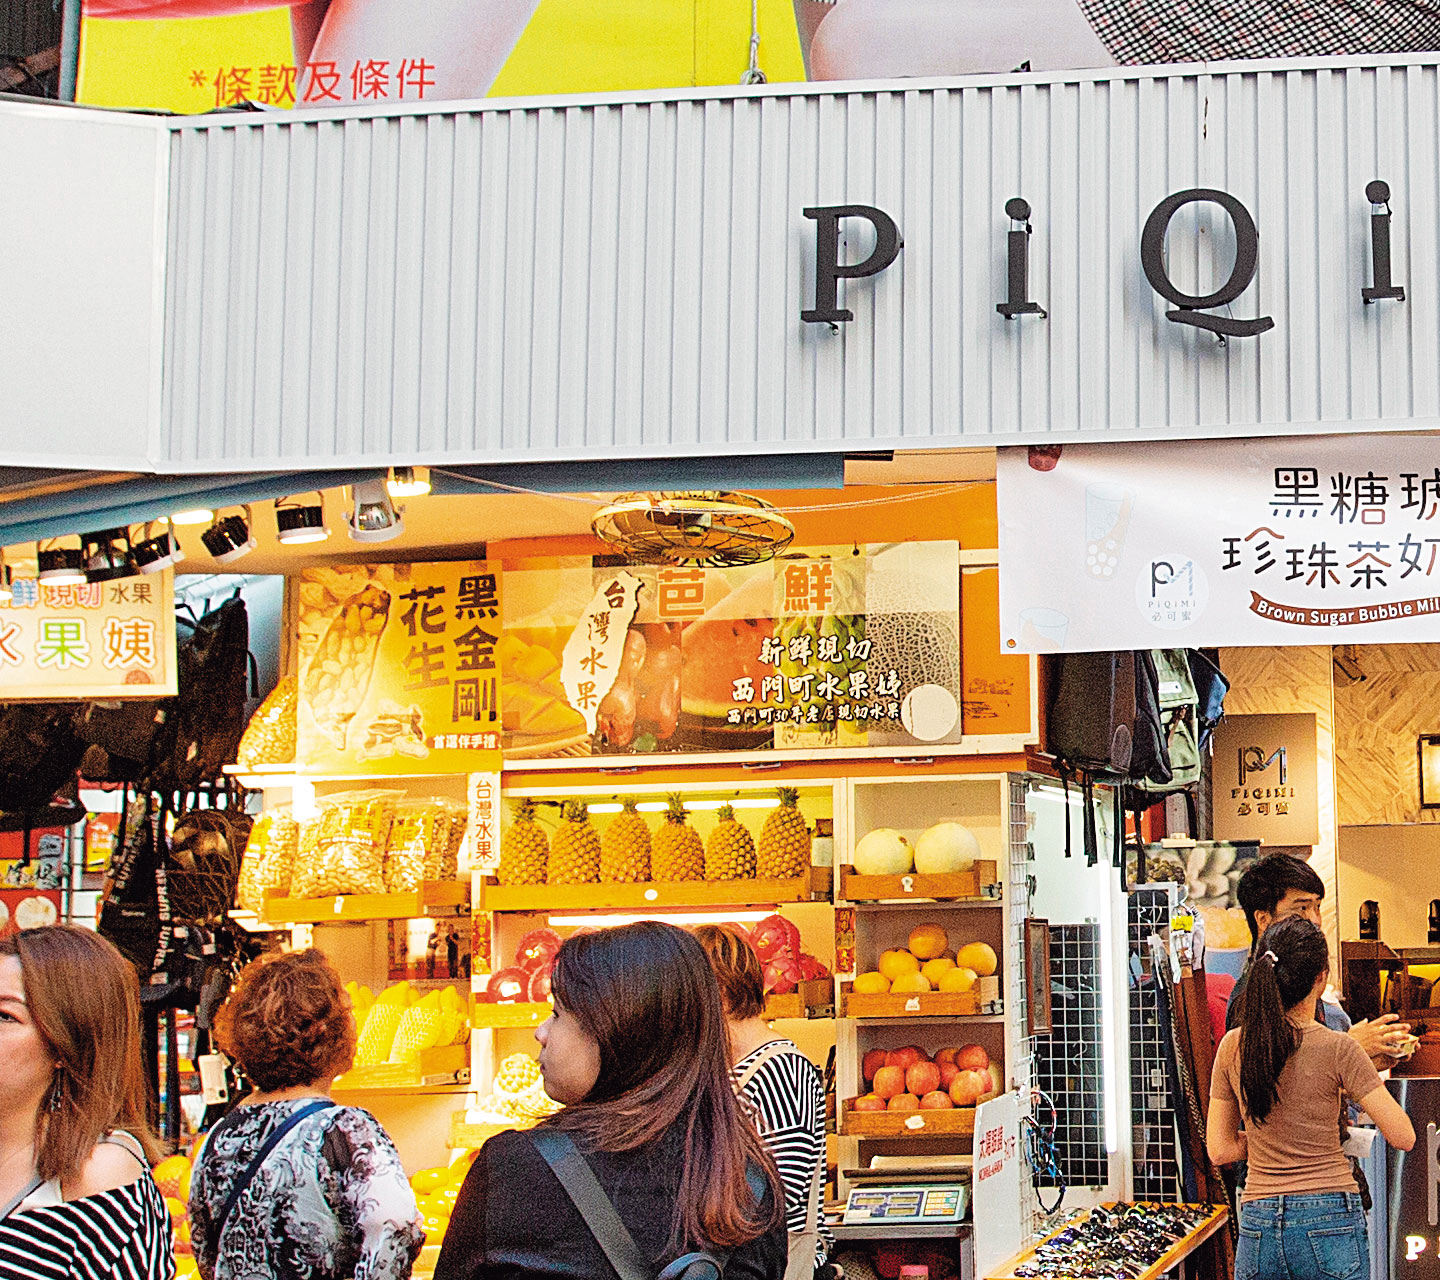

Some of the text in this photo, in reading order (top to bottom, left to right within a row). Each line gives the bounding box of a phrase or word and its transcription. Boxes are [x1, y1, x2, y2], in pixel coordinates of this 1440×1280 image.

[783, 563, 833, 613] 鮮
[1256, 600, 1305, 622] Brown
[1310, 610, 1355, 627] Sugar
[1359, 603, 1413, 621] Bubble
[399, 585, 450, 691] 花生
[452, 573, 499, 722] 黑金剛
[576, 580, 628, 710] 台灣水果
[758, 635, 873, 667] 新鮮現切
[732, 670, 902, 703] 西門町水果姨
[474, 779, 495, 861] 台灣水果
